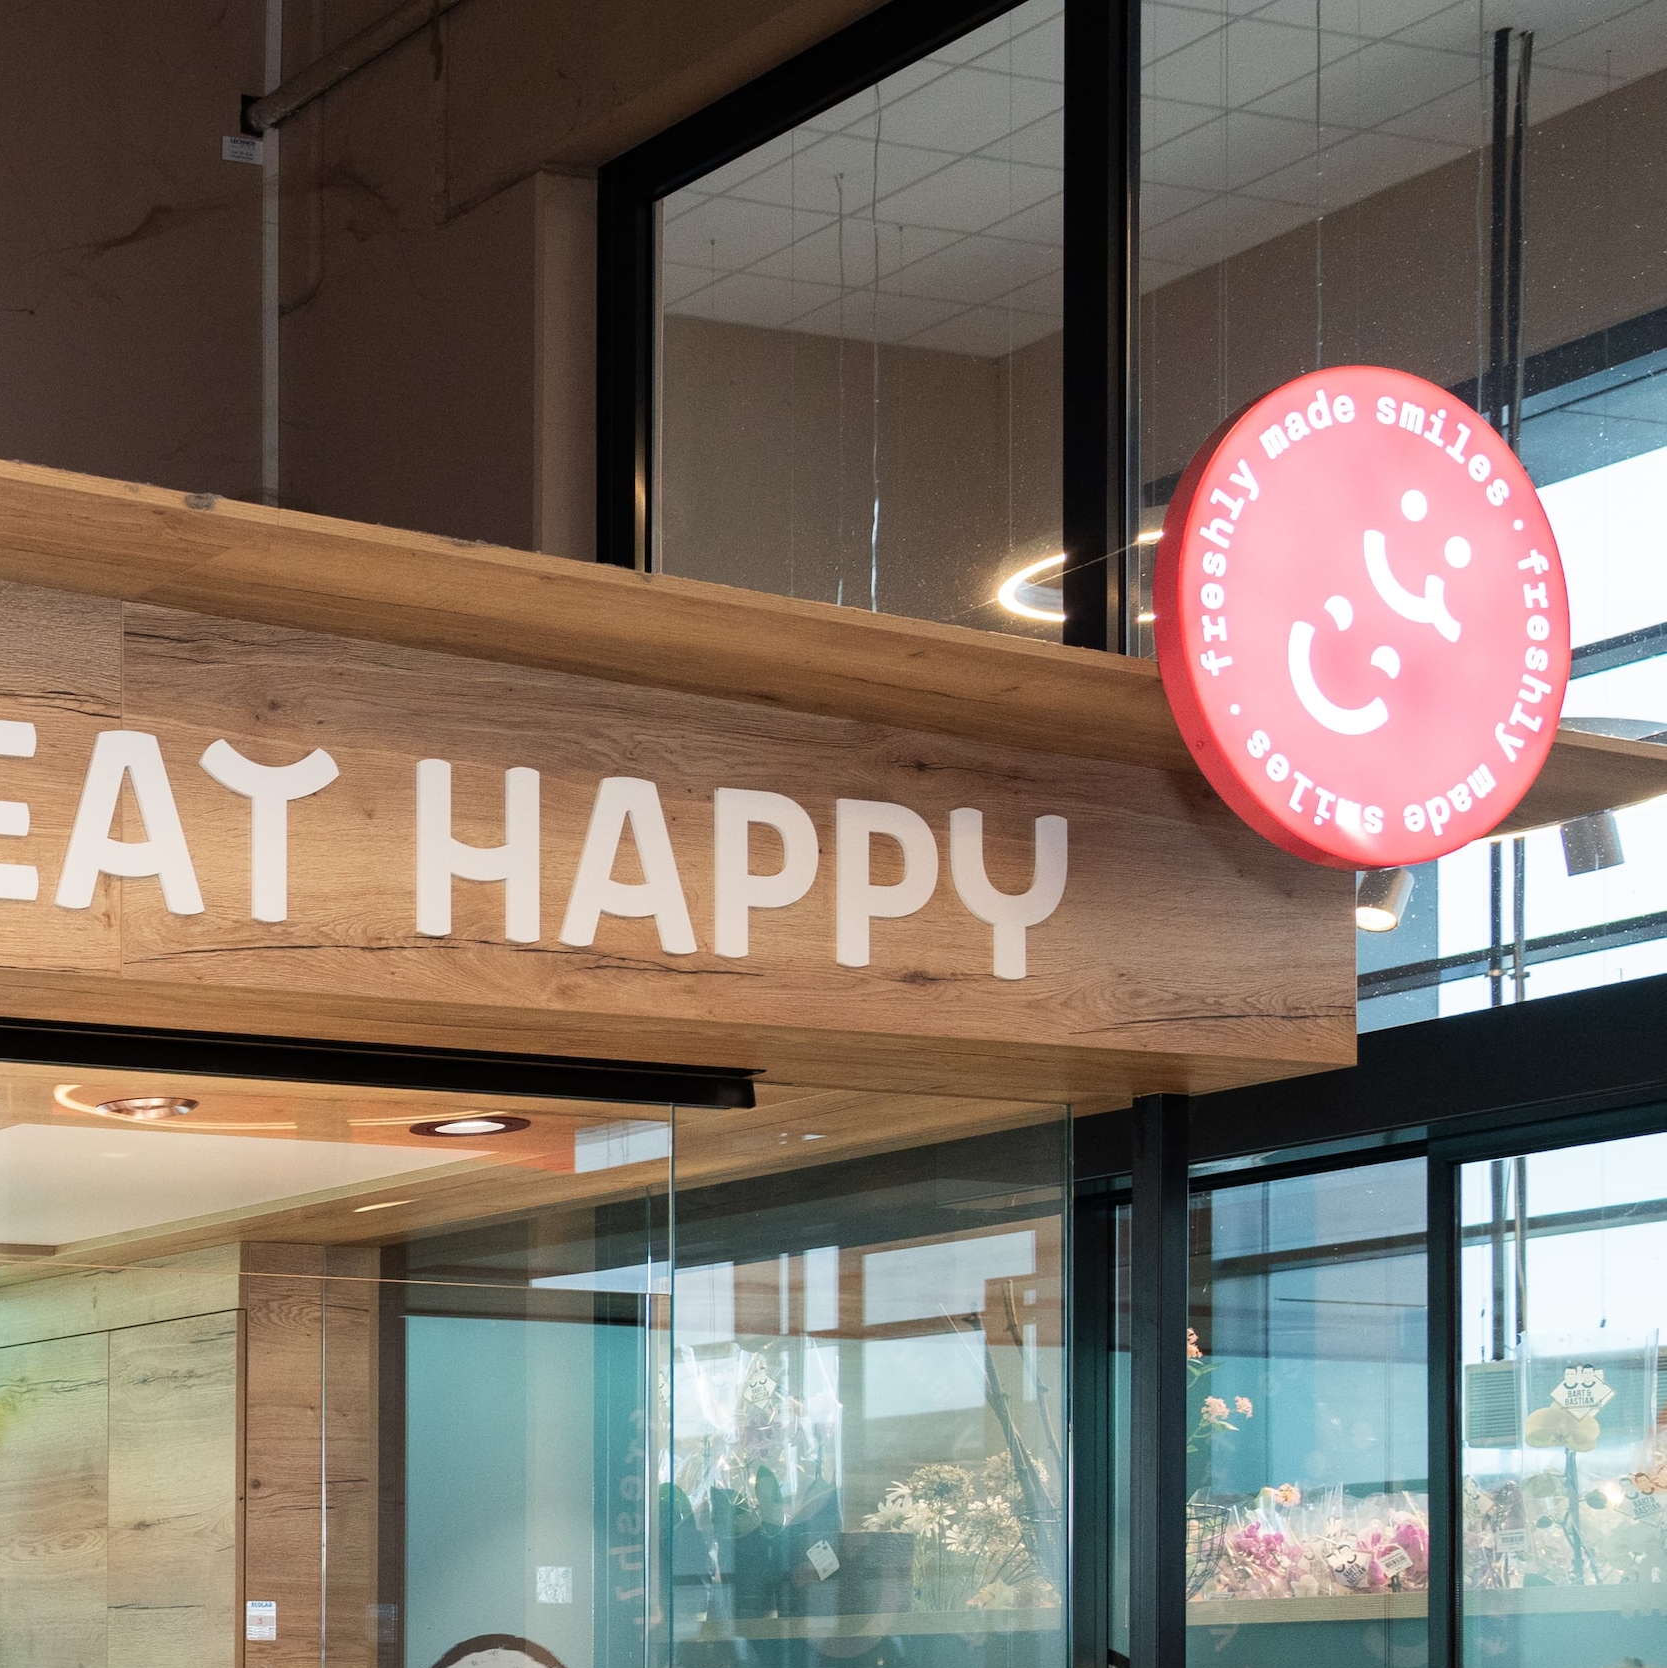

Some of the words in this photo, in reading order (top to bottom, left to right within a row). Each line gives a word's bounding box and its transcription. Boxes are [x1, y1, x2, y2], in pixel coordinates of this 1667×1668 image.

[1199, 457, 1261, 677] freshly
[1258, 388, 1355, 461] made
[1374, 394, 1511, 507] smiles
[1494, 547, 1552, 764] freshly
[1245, 728, 1383, 835] smiles
[1403, 762, 1497, 836] made
[415, 757, 1070, 981] HAPPY
[1564, 1397, 1595, 1406] BASTIAN
[1567, 1389, 1586, 1398] BART
